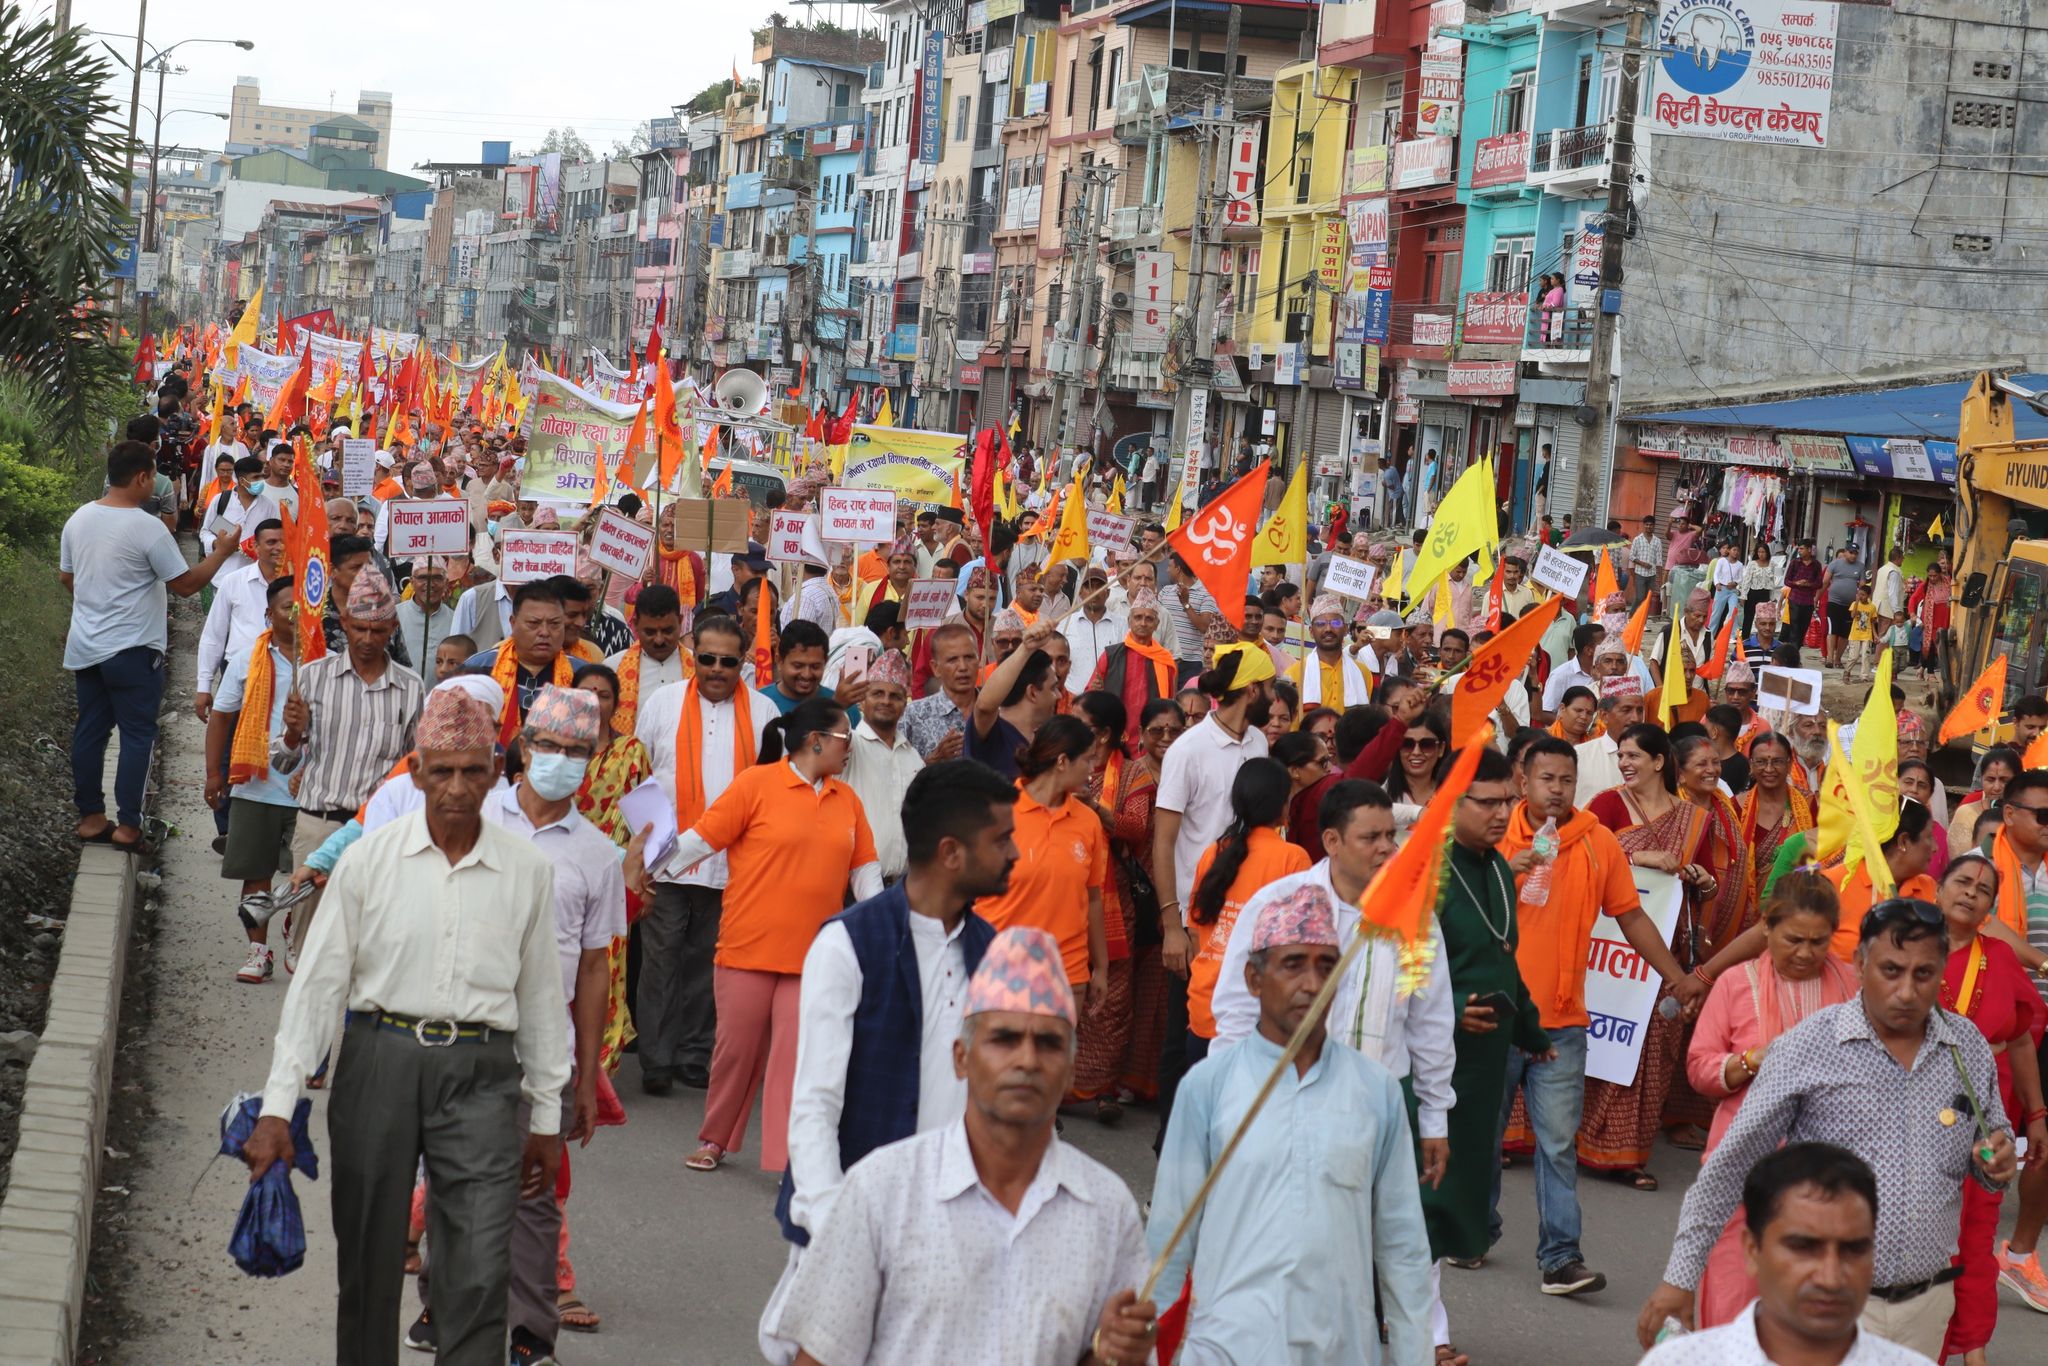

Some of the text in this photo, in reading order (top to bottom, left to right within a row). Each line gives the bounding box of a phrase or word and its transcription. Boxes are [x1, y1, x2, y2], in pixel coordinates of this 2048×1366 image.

[1659, 6, 1681, 42] CITY
[1734, 8, 1756, 49] CARE
[988, 52, 1009, 72] ITC
[1759, 50, 1832, 70] 986-6483505
[1422, 79, 1458, 99] JAPAN
[1757, 70, 1831, 90] 9855012046
[1655, 92, 1824, 144] सिटी डेण्टल केयर
[1774, 136, 1800, 144] Network
[1226, 142, 1254, 223] ITC
[1355, 213, 1386, 242] JAPAN
[113, 247, 132, 260] 4G
[1370, 276, 1392, 287] JAPAN
[1145, 263, 1159, 325] ITC
[1373, 292, 1383, 329] NAMASTE
[541, 414, 577, 437] गोवंश
[582, 424, 609, 441] रक्षा
[739, 475, 780, 489] SERVICE
[869, 497, 892, 513] नेपाल
[394, 506, 465, 525] नेपाल आमाको
[833, 517, 857, 530] कायम
[408, 535, 427, 548] जय
